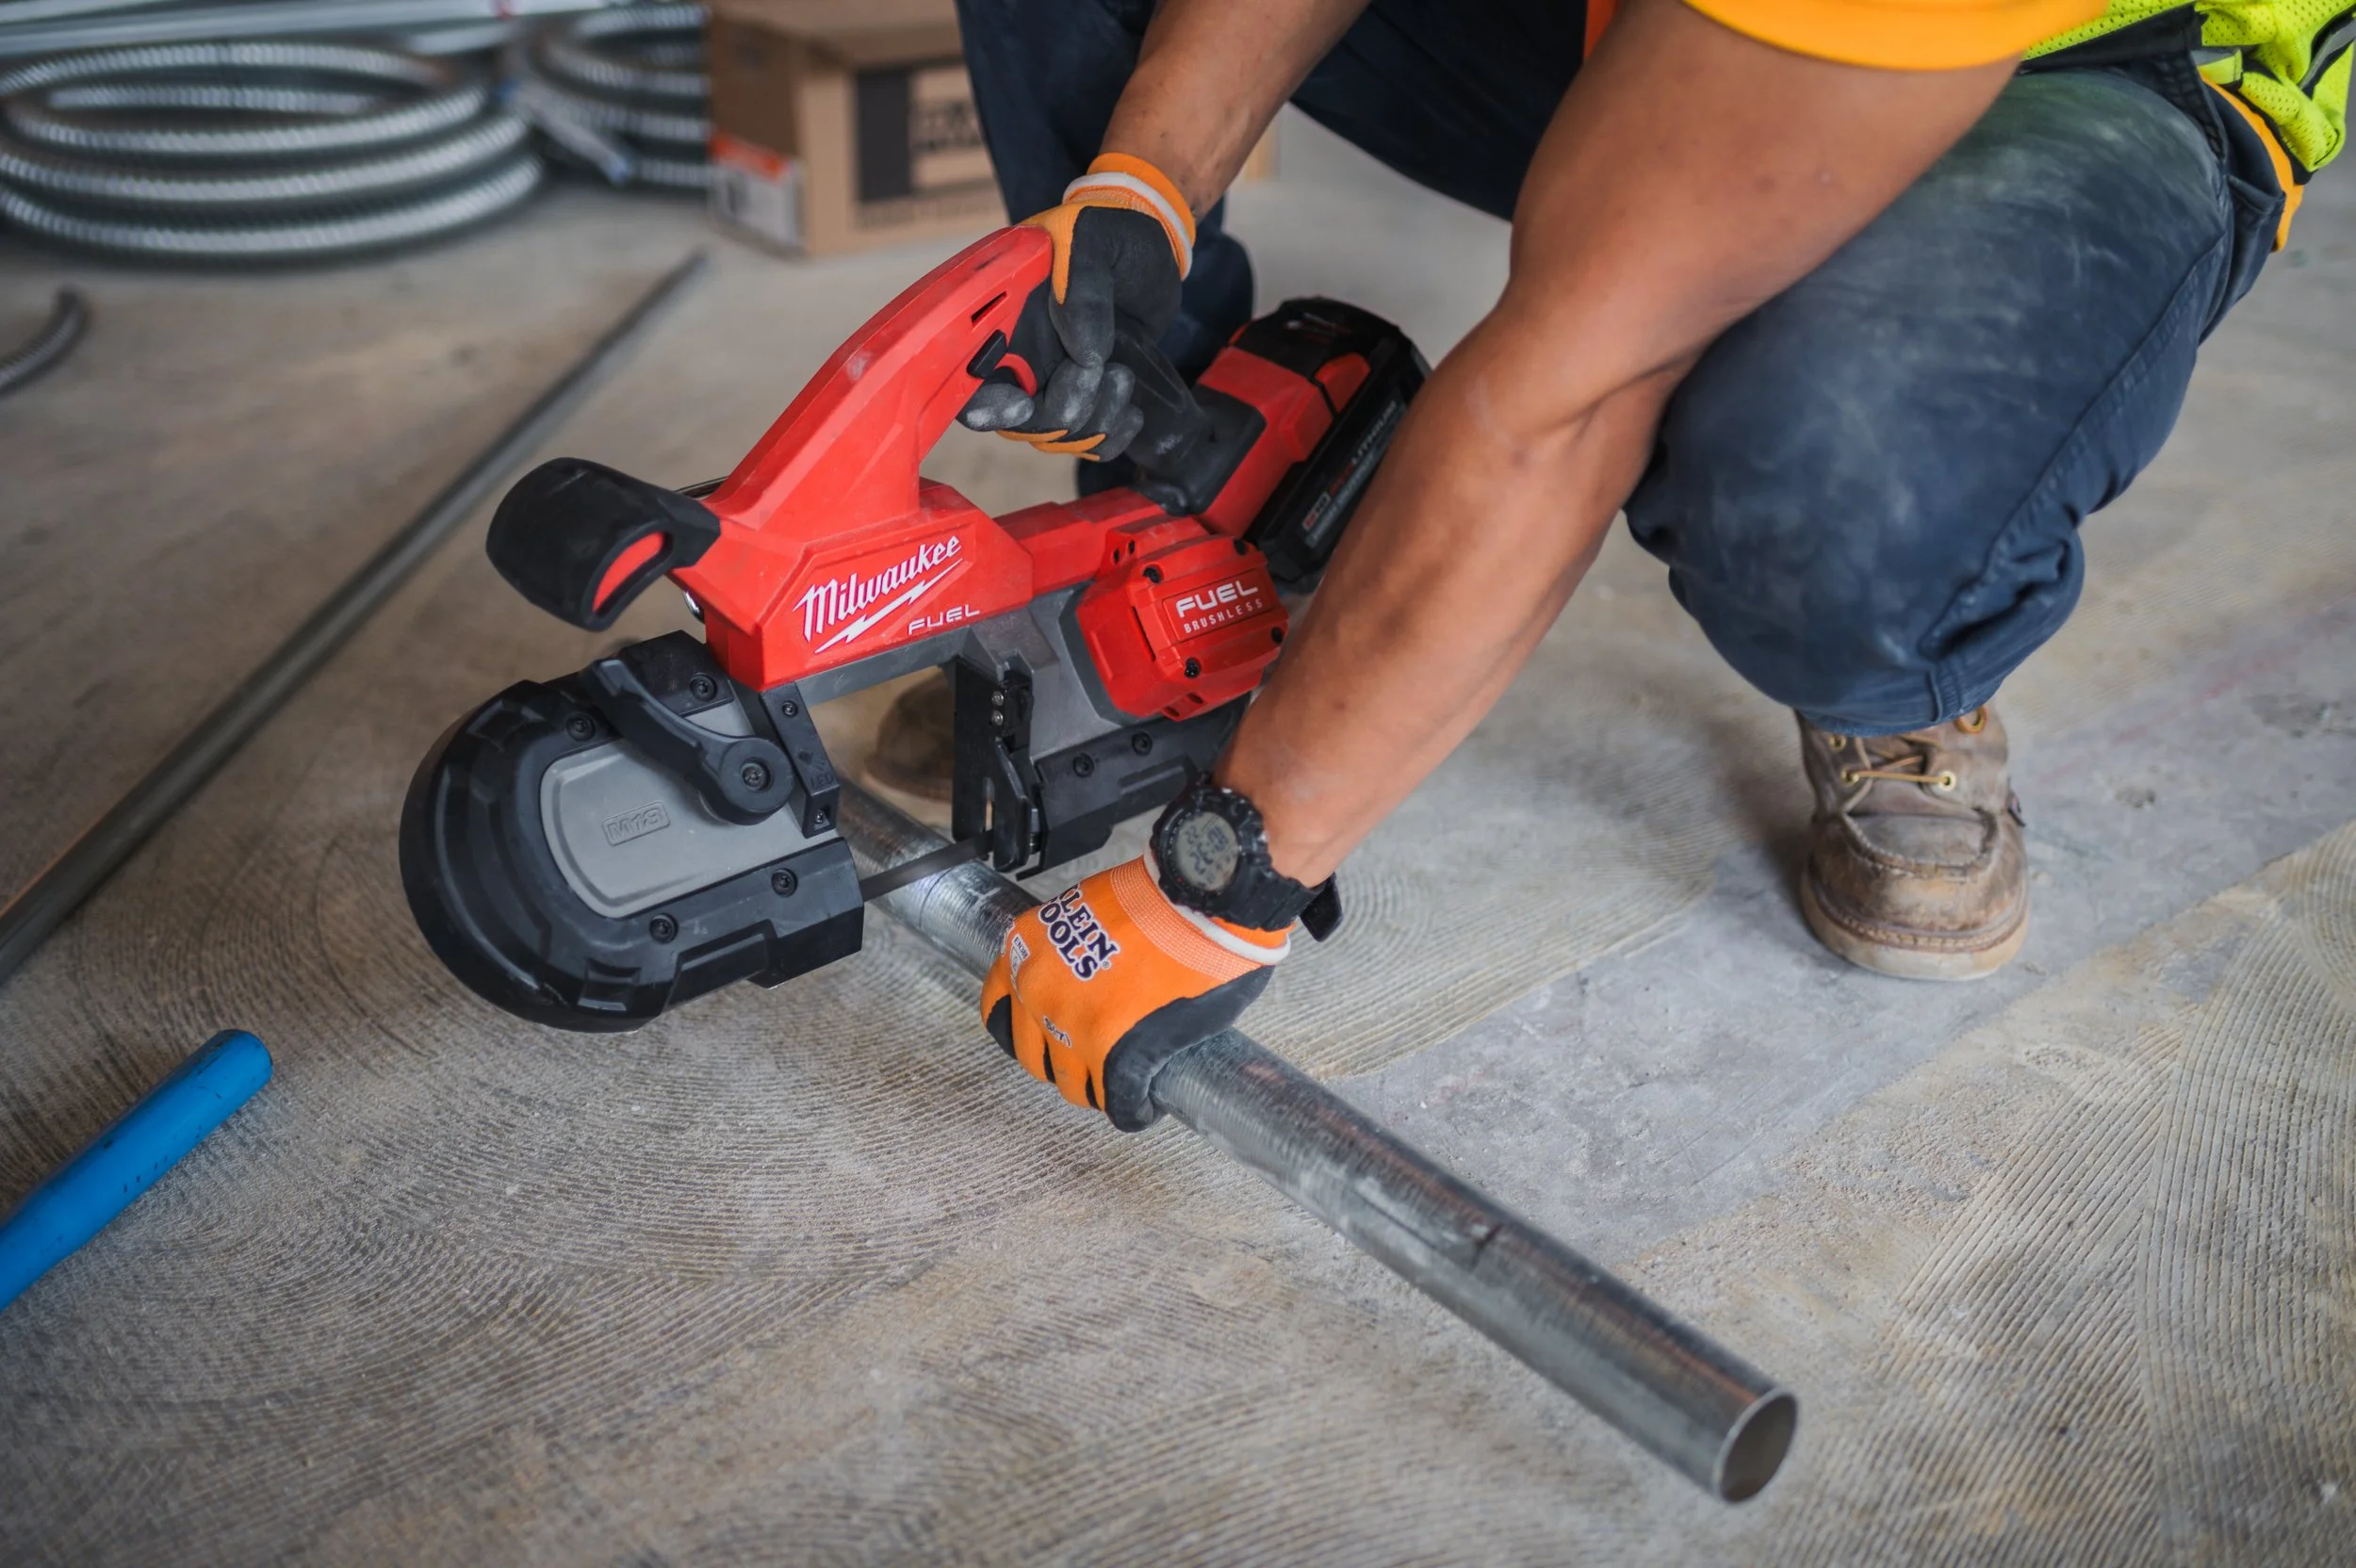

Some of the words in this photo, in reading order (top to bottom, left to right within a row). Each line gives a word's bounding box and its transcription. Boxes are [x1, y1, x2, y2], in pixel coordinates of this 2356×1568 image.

[793, 535, 961, 642] Milwaukee
[1176, 580, 1258, 618] FUEL
[908, 604, 980, 635] FUEL
[1184, 598, 1263, 633] BRUSHLESS
[811, 773, 834, 790] LED
[607, 808, 662, 841] M18
[1039, 896, 1099, 979] OOLS
[1059, 883, 1119, 962] LEIN
